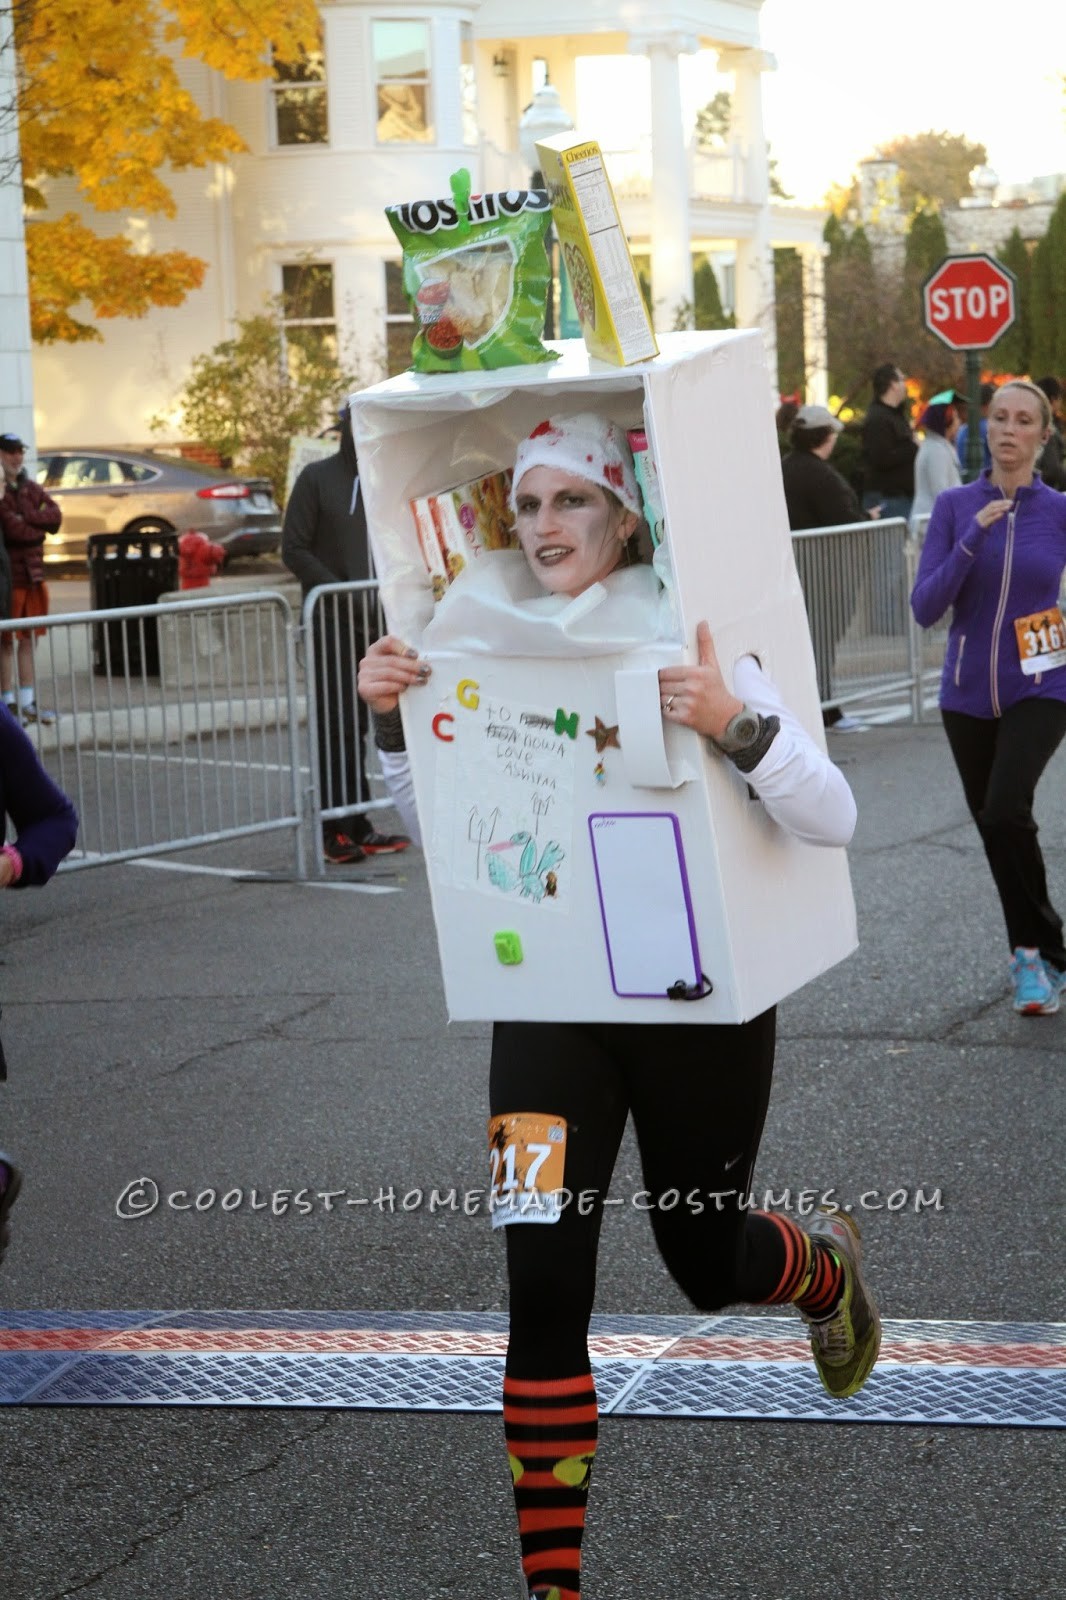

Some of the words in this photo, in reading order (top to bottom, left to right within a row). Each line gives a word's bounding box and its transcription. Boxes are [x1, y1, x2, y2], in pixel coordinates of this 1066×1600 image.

[931, 284, 1007, 321] STOP
[456, 679, 479, 711] G
[432, 712, 454, 742] C
[554, 707, 579, 740] N
